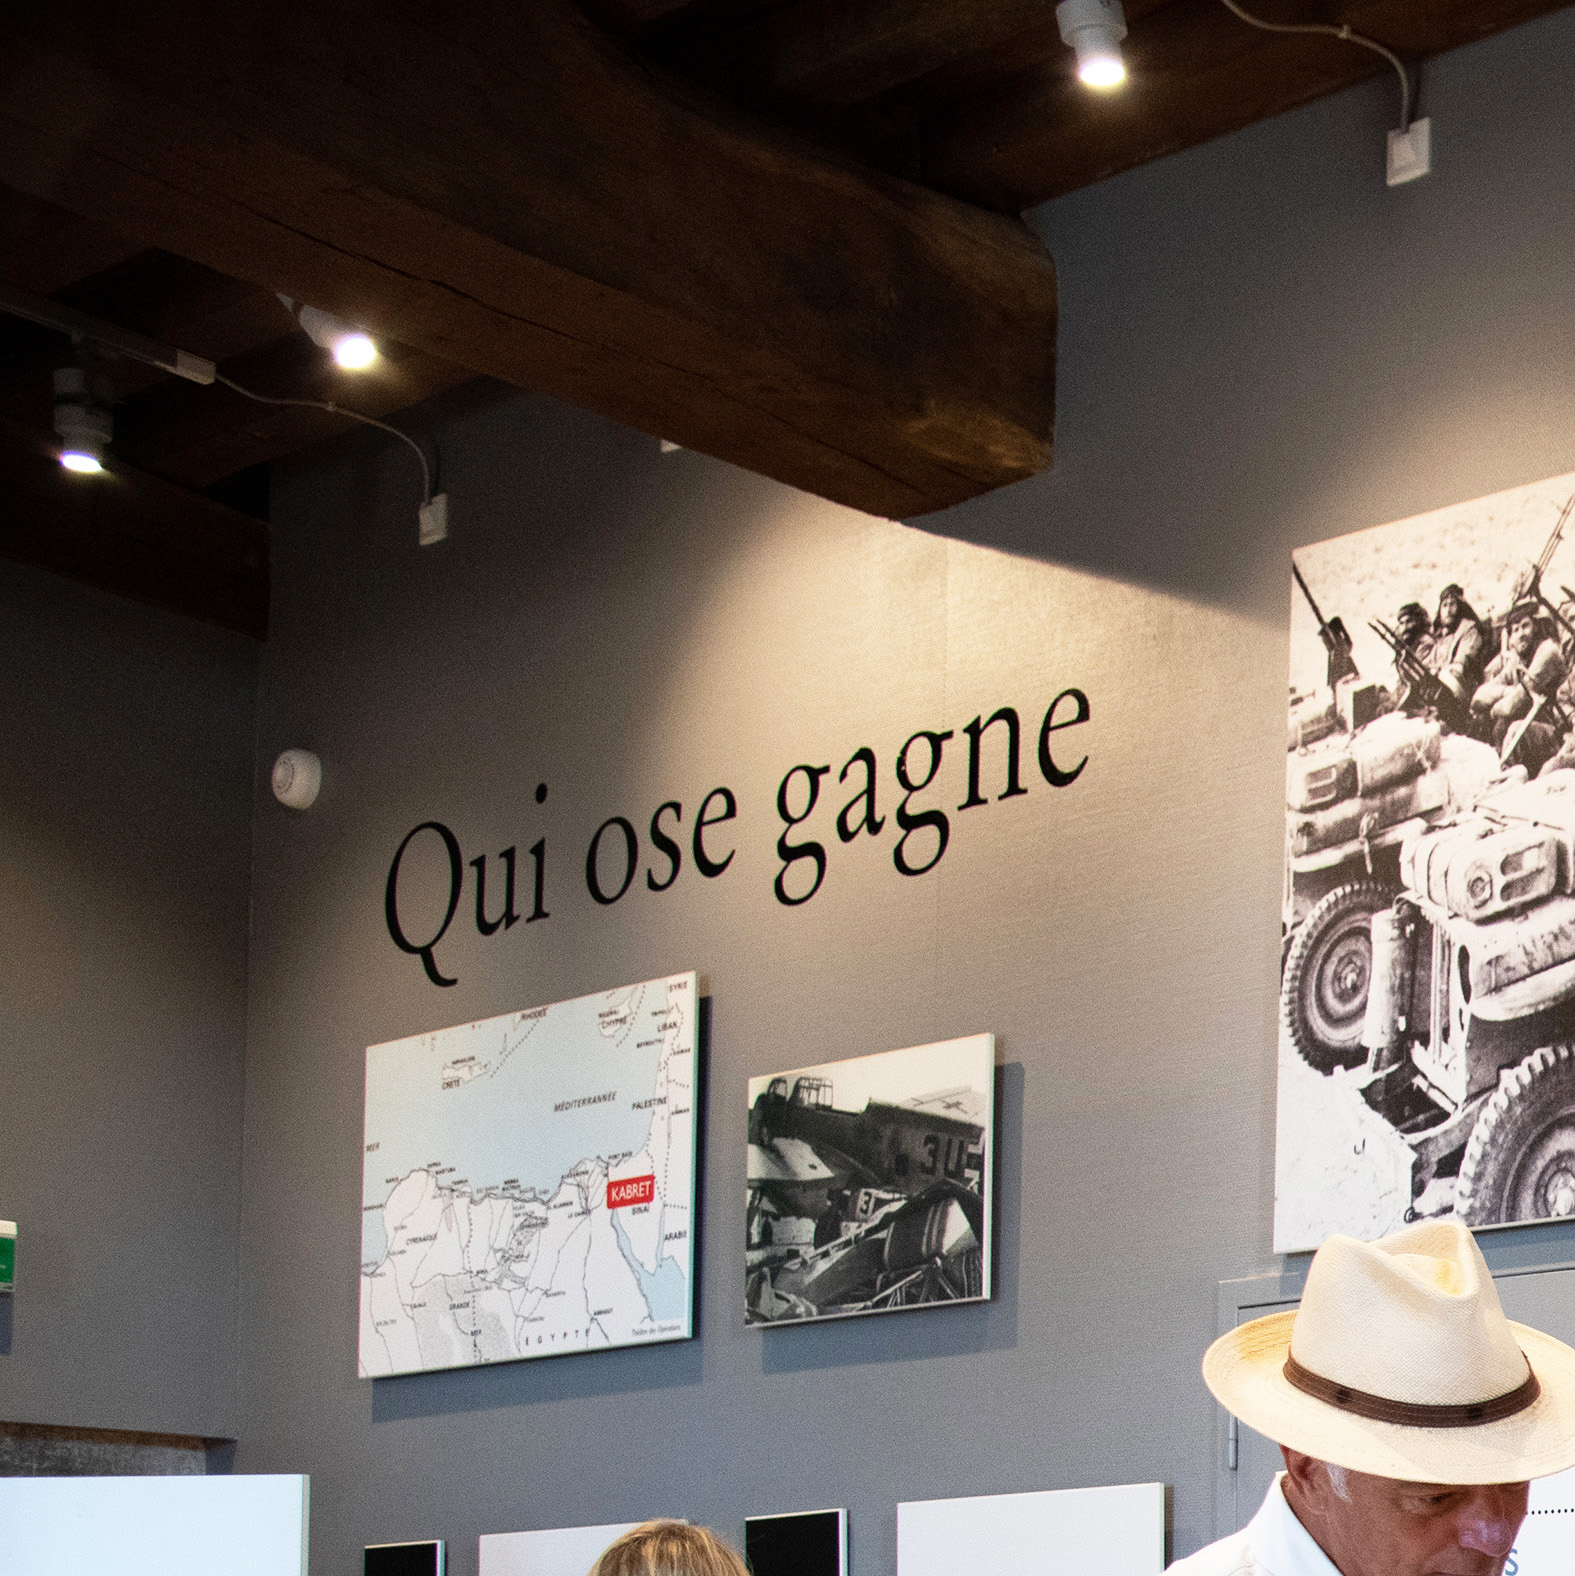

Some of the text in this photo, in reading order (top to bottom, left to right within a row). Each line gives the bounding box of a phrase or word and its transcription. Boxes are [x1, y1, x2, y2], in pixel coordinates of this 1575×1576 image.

[385, 689, 1089, 987] Qui ose gagne
[611, 1180, 652, 1202] KABRET
